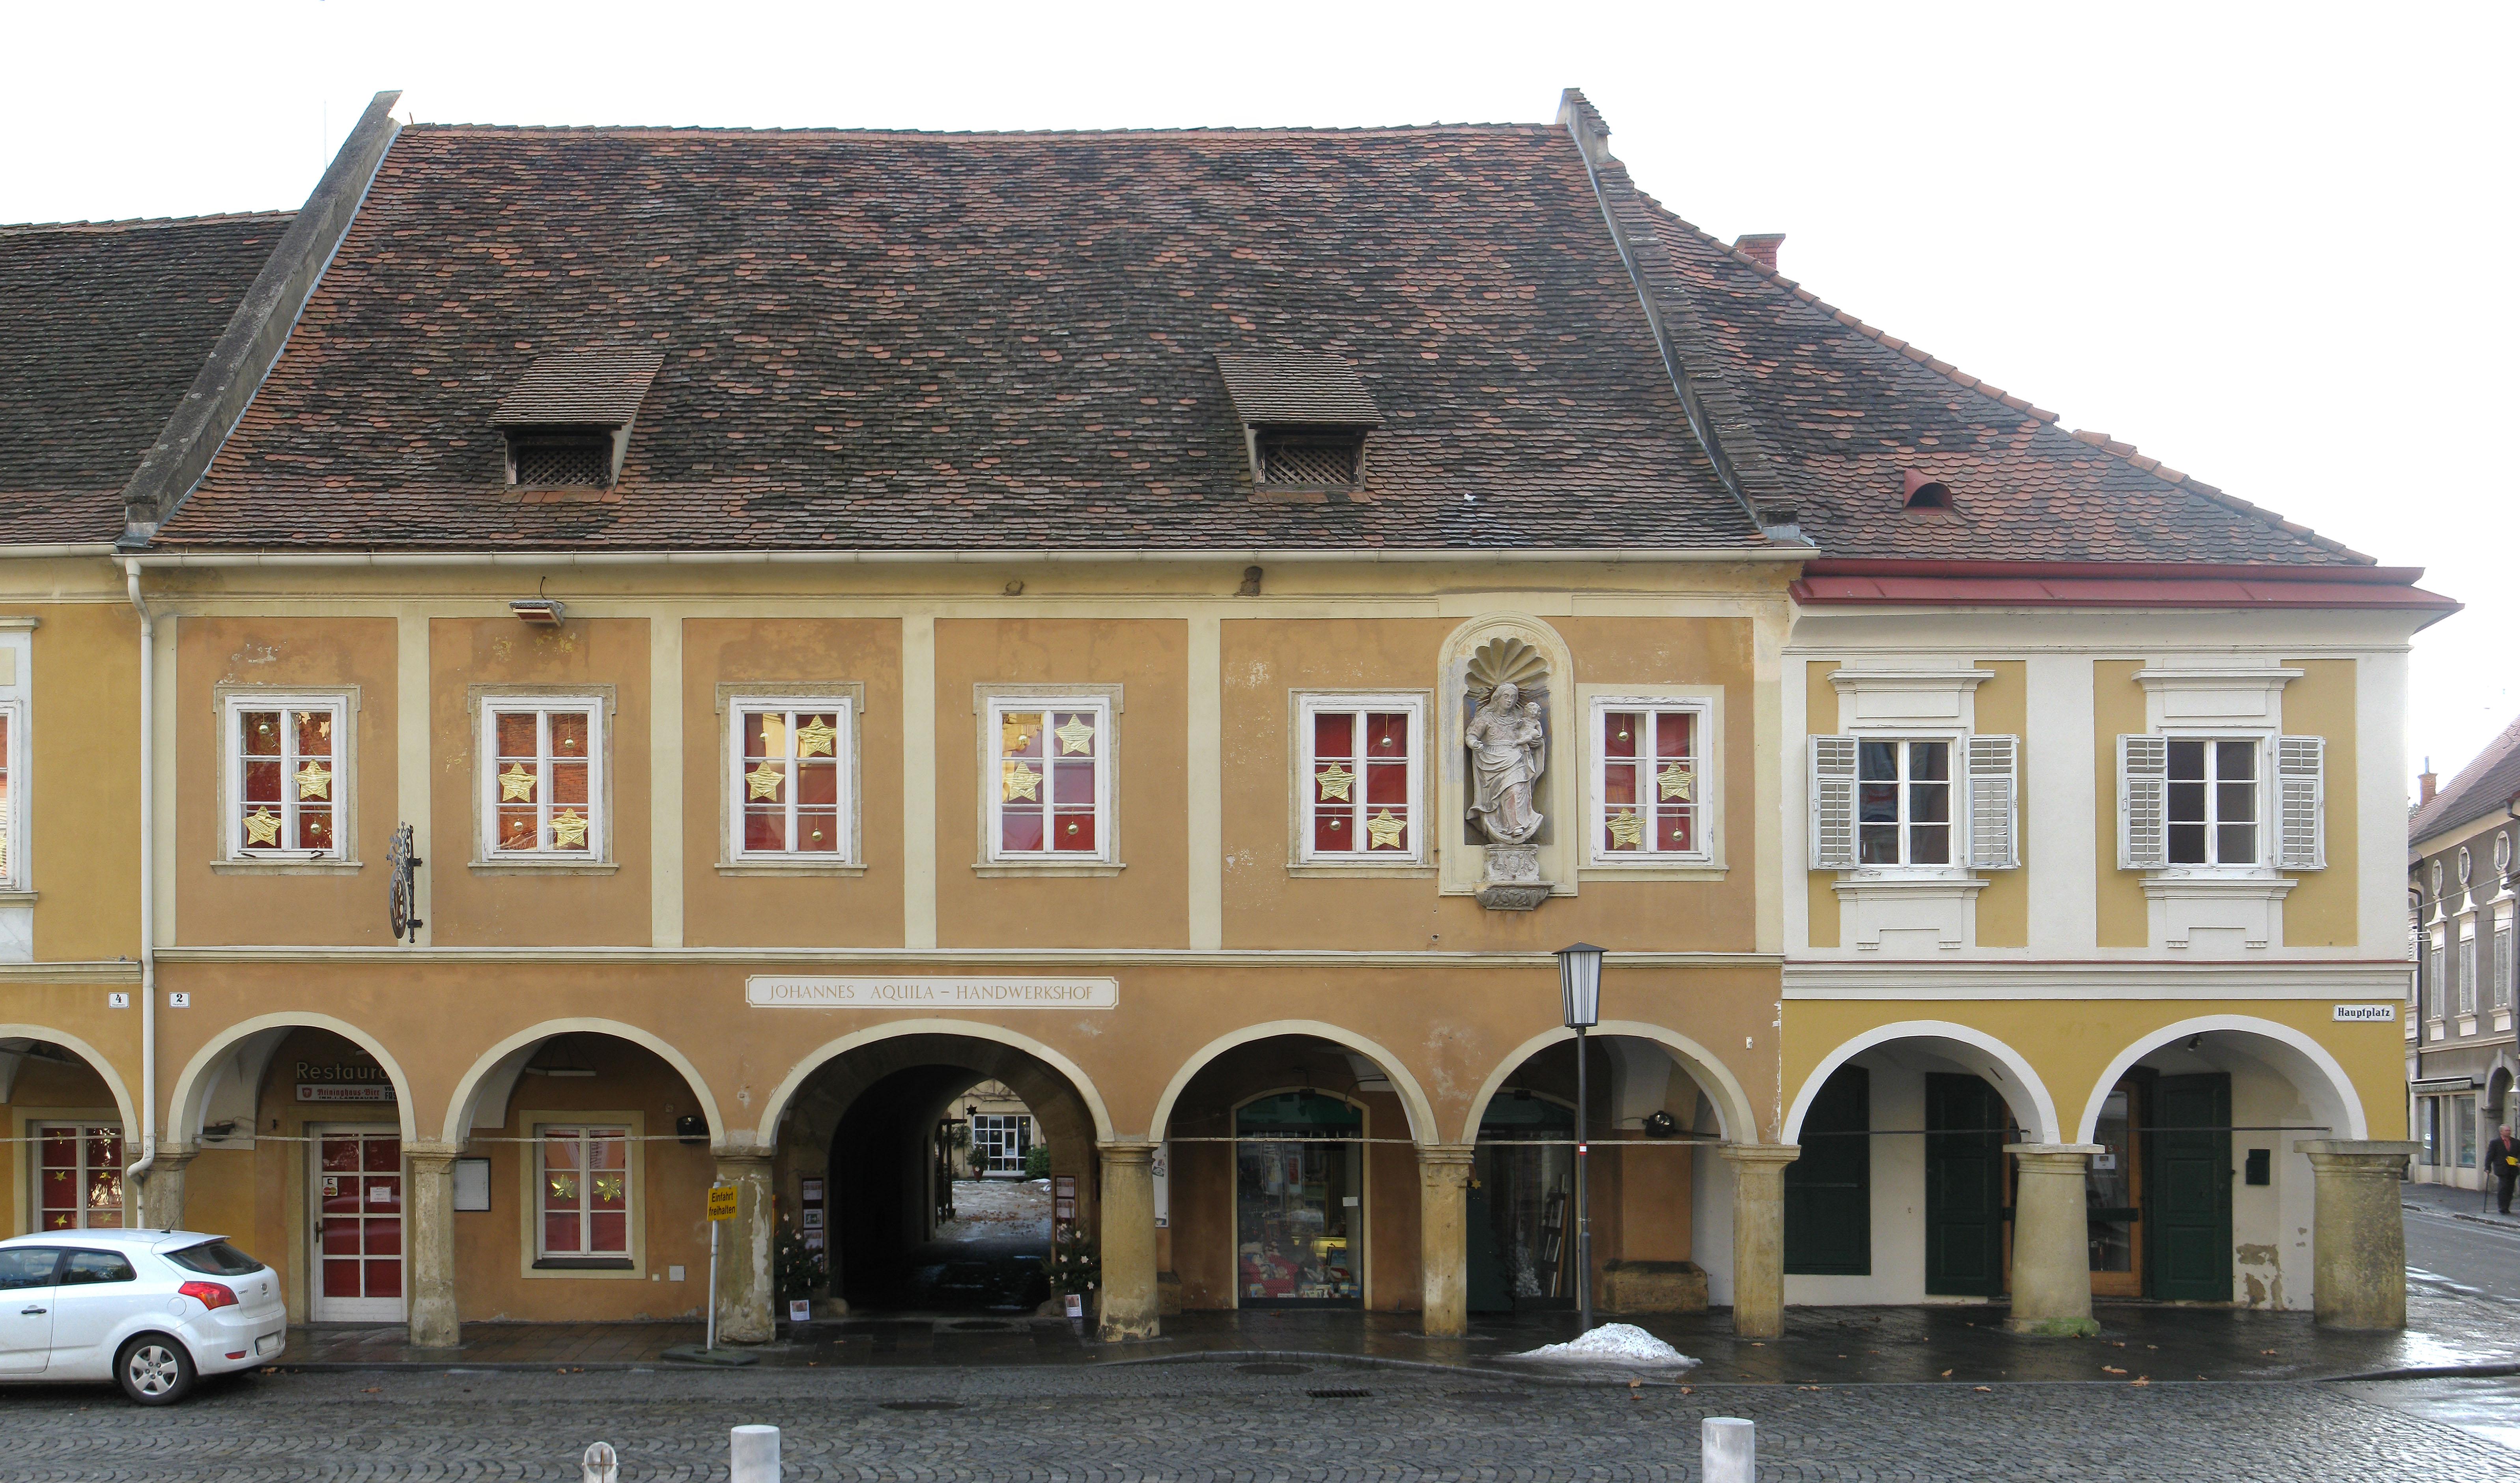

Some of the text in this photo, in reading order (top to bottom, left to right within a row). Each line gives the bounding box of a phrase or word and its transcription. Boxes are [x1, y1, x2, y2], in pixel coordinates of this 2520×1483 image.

[116, 994, 122, 1003] 4
[176, 993, 183, 1002] 2
[768, 985, 854, 1001] JOHANNES
[871, 985, 934, 1001] AQUILA
[956, 986, 1093, 999] HANDWERKSHOF
[2338, 1007, 2390, 1018] Hauptplatz
[317, 1088, 380, 1096] Reininghaus-Bier
[712, 1191, 733, 1202] Einfahrt
[709, 1204, 735, 1216] freihalten
